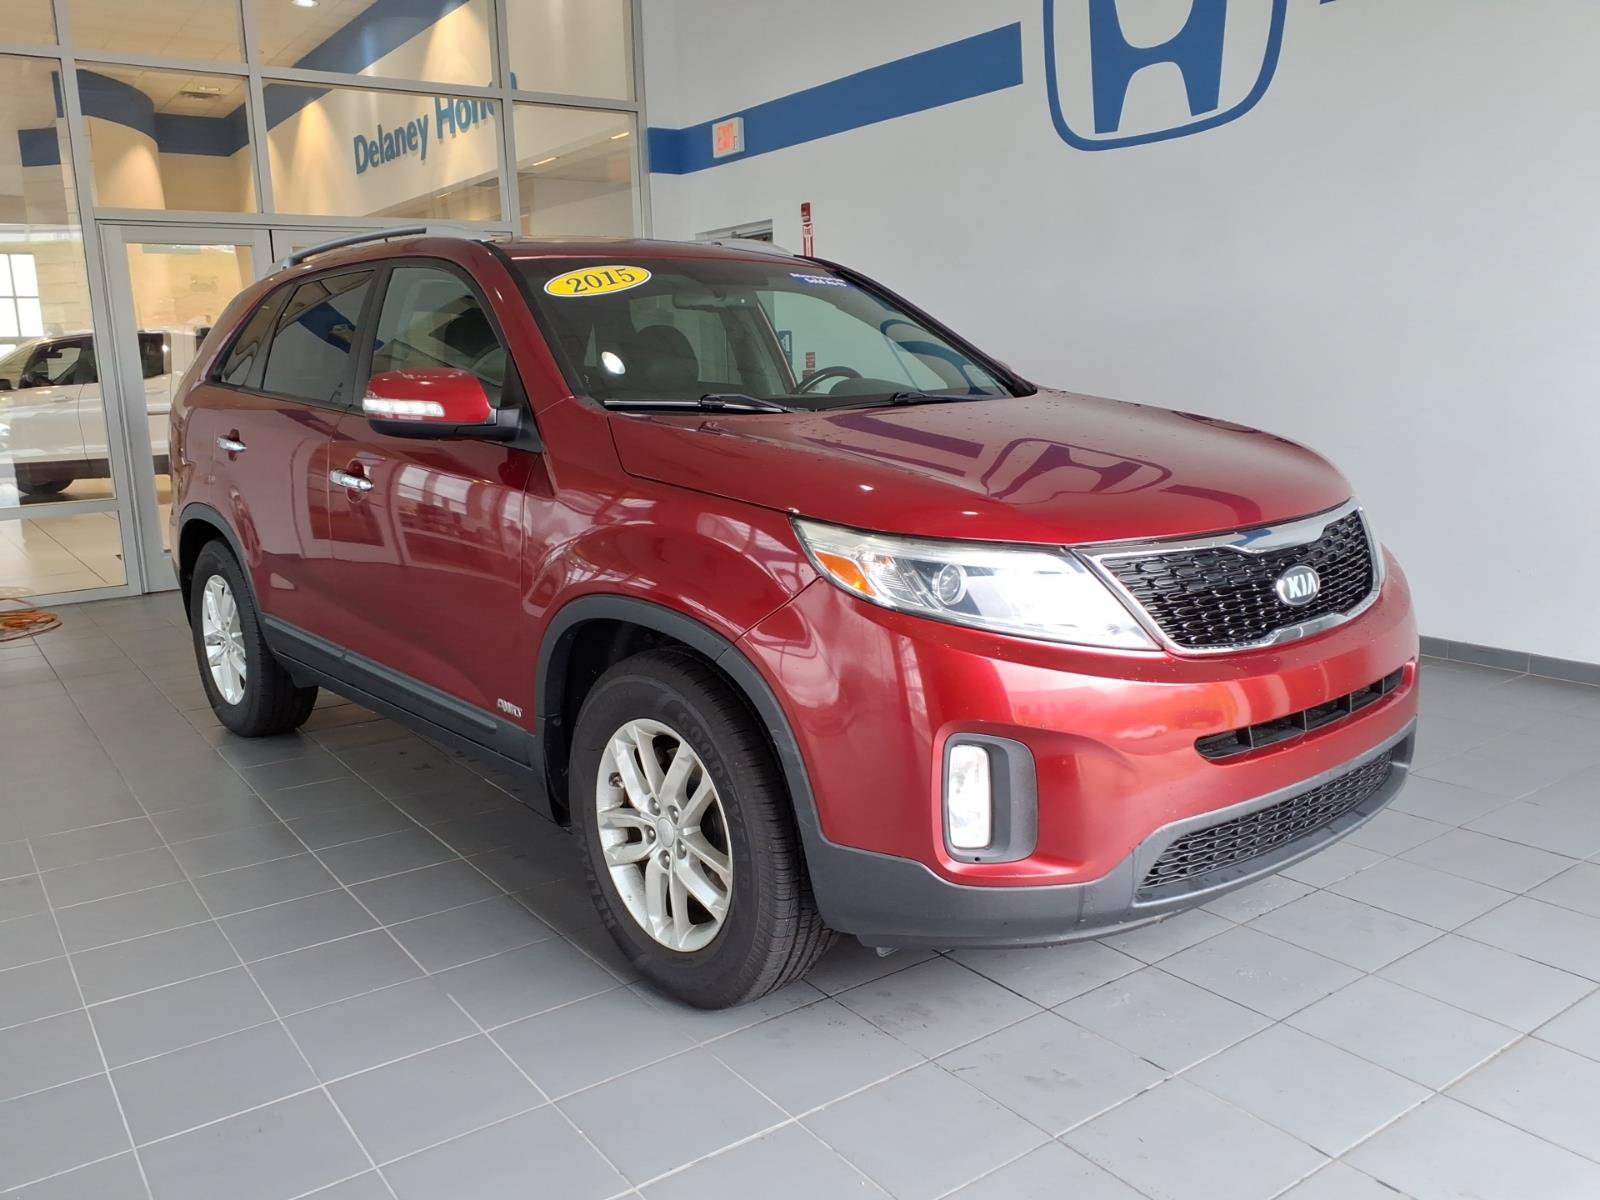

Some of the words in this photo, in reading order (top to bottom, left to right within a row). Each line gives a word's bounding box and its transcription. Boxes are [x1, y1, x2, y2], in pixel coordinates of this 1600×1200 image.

[353, 114, 429, 175] Delaney
[566, 268, 635, 293] 2015
[1286, 572, 1317, 599] KIA
